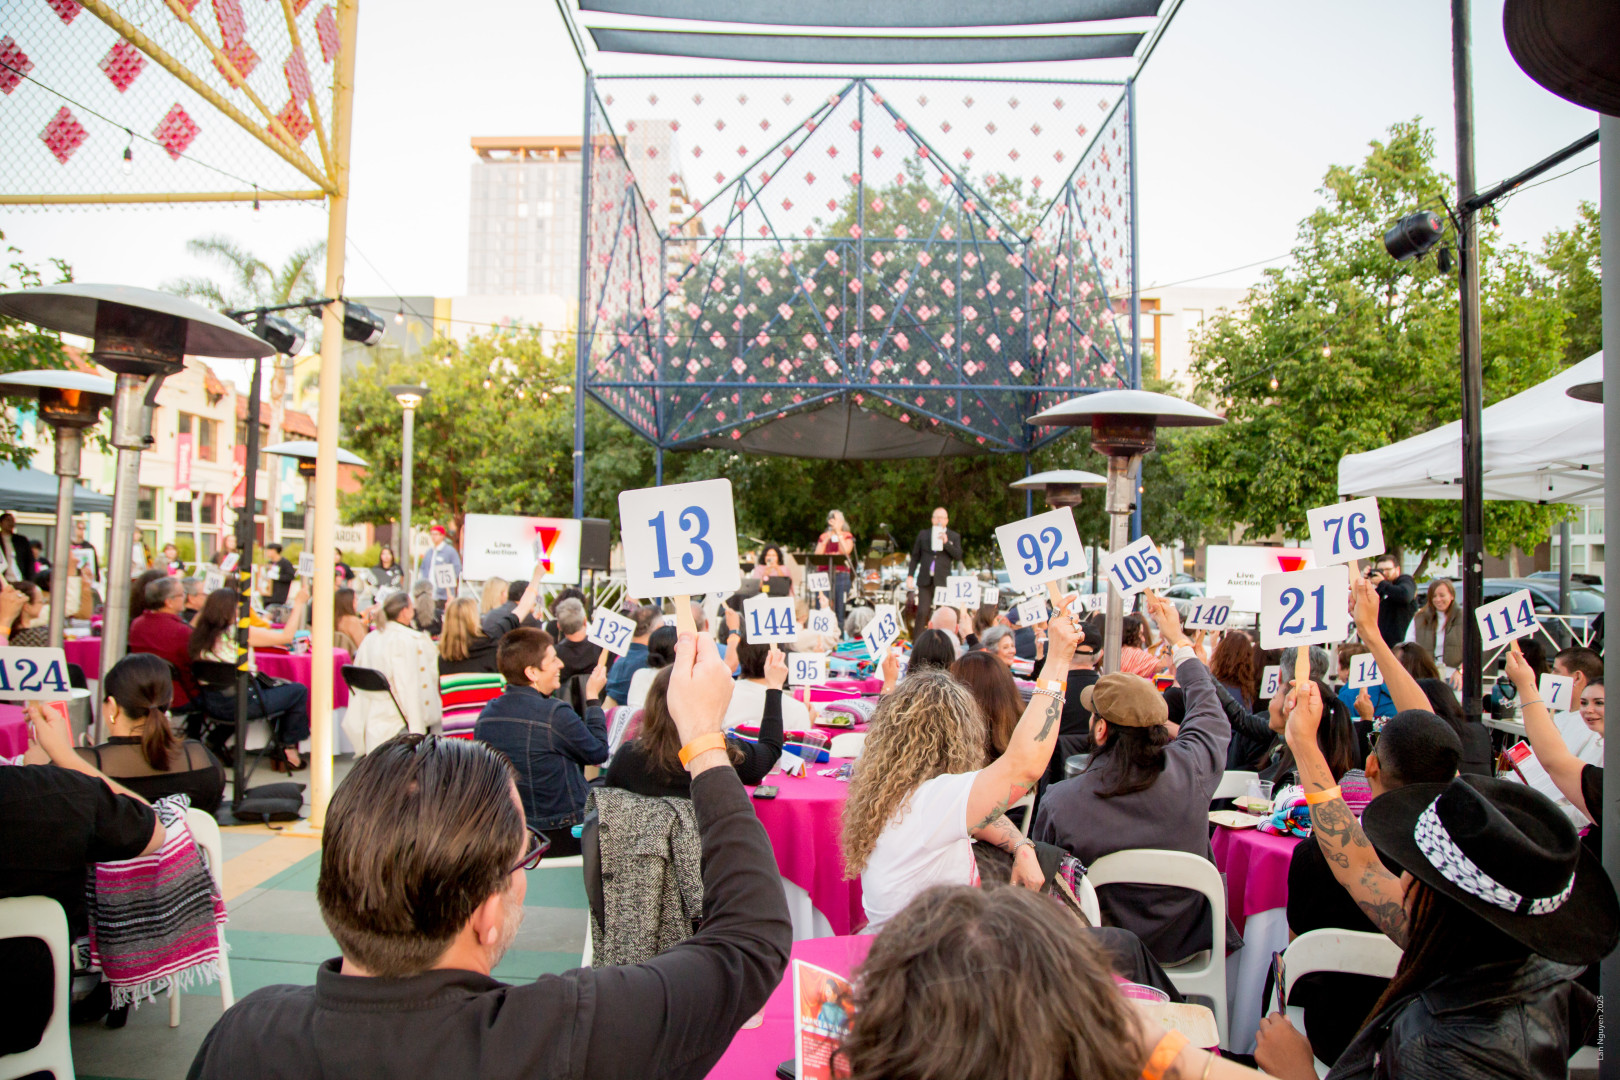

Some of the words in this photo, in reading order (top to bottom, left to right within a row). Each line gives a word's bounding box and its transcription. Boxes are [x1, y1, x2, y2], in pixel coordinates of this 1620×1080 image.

[648, 505, 714, 579] 13
[1323, 512, 1370, 555] 76
[484, 548, 518, 556] Auction
[1017, 526, 1070, 576] 92
[438, 569, 453, 586] 75
[1111, 545, 1163, 591] 105
[1235, 571, 1255, 580] Live
[954, 581, 974, 600] 12
[750, 607, 796, 636] 144
[1190, 604, 1230, 626] 140
[1278, 585, 1328, 635] 21
[1483, 599, 1536, 641] 114
[594, 617, 632, 648] 137
[813, 616, 830, 633] 68
[867, 613, 896, 653] 143
[0, 658, 69, 692] 124
[796, 660, 818, 680] 95
[1358, 660, 1378, 682] 14
[1267, 673, 1279, 694] 5
[1551, 682, 1562, 704] 7
